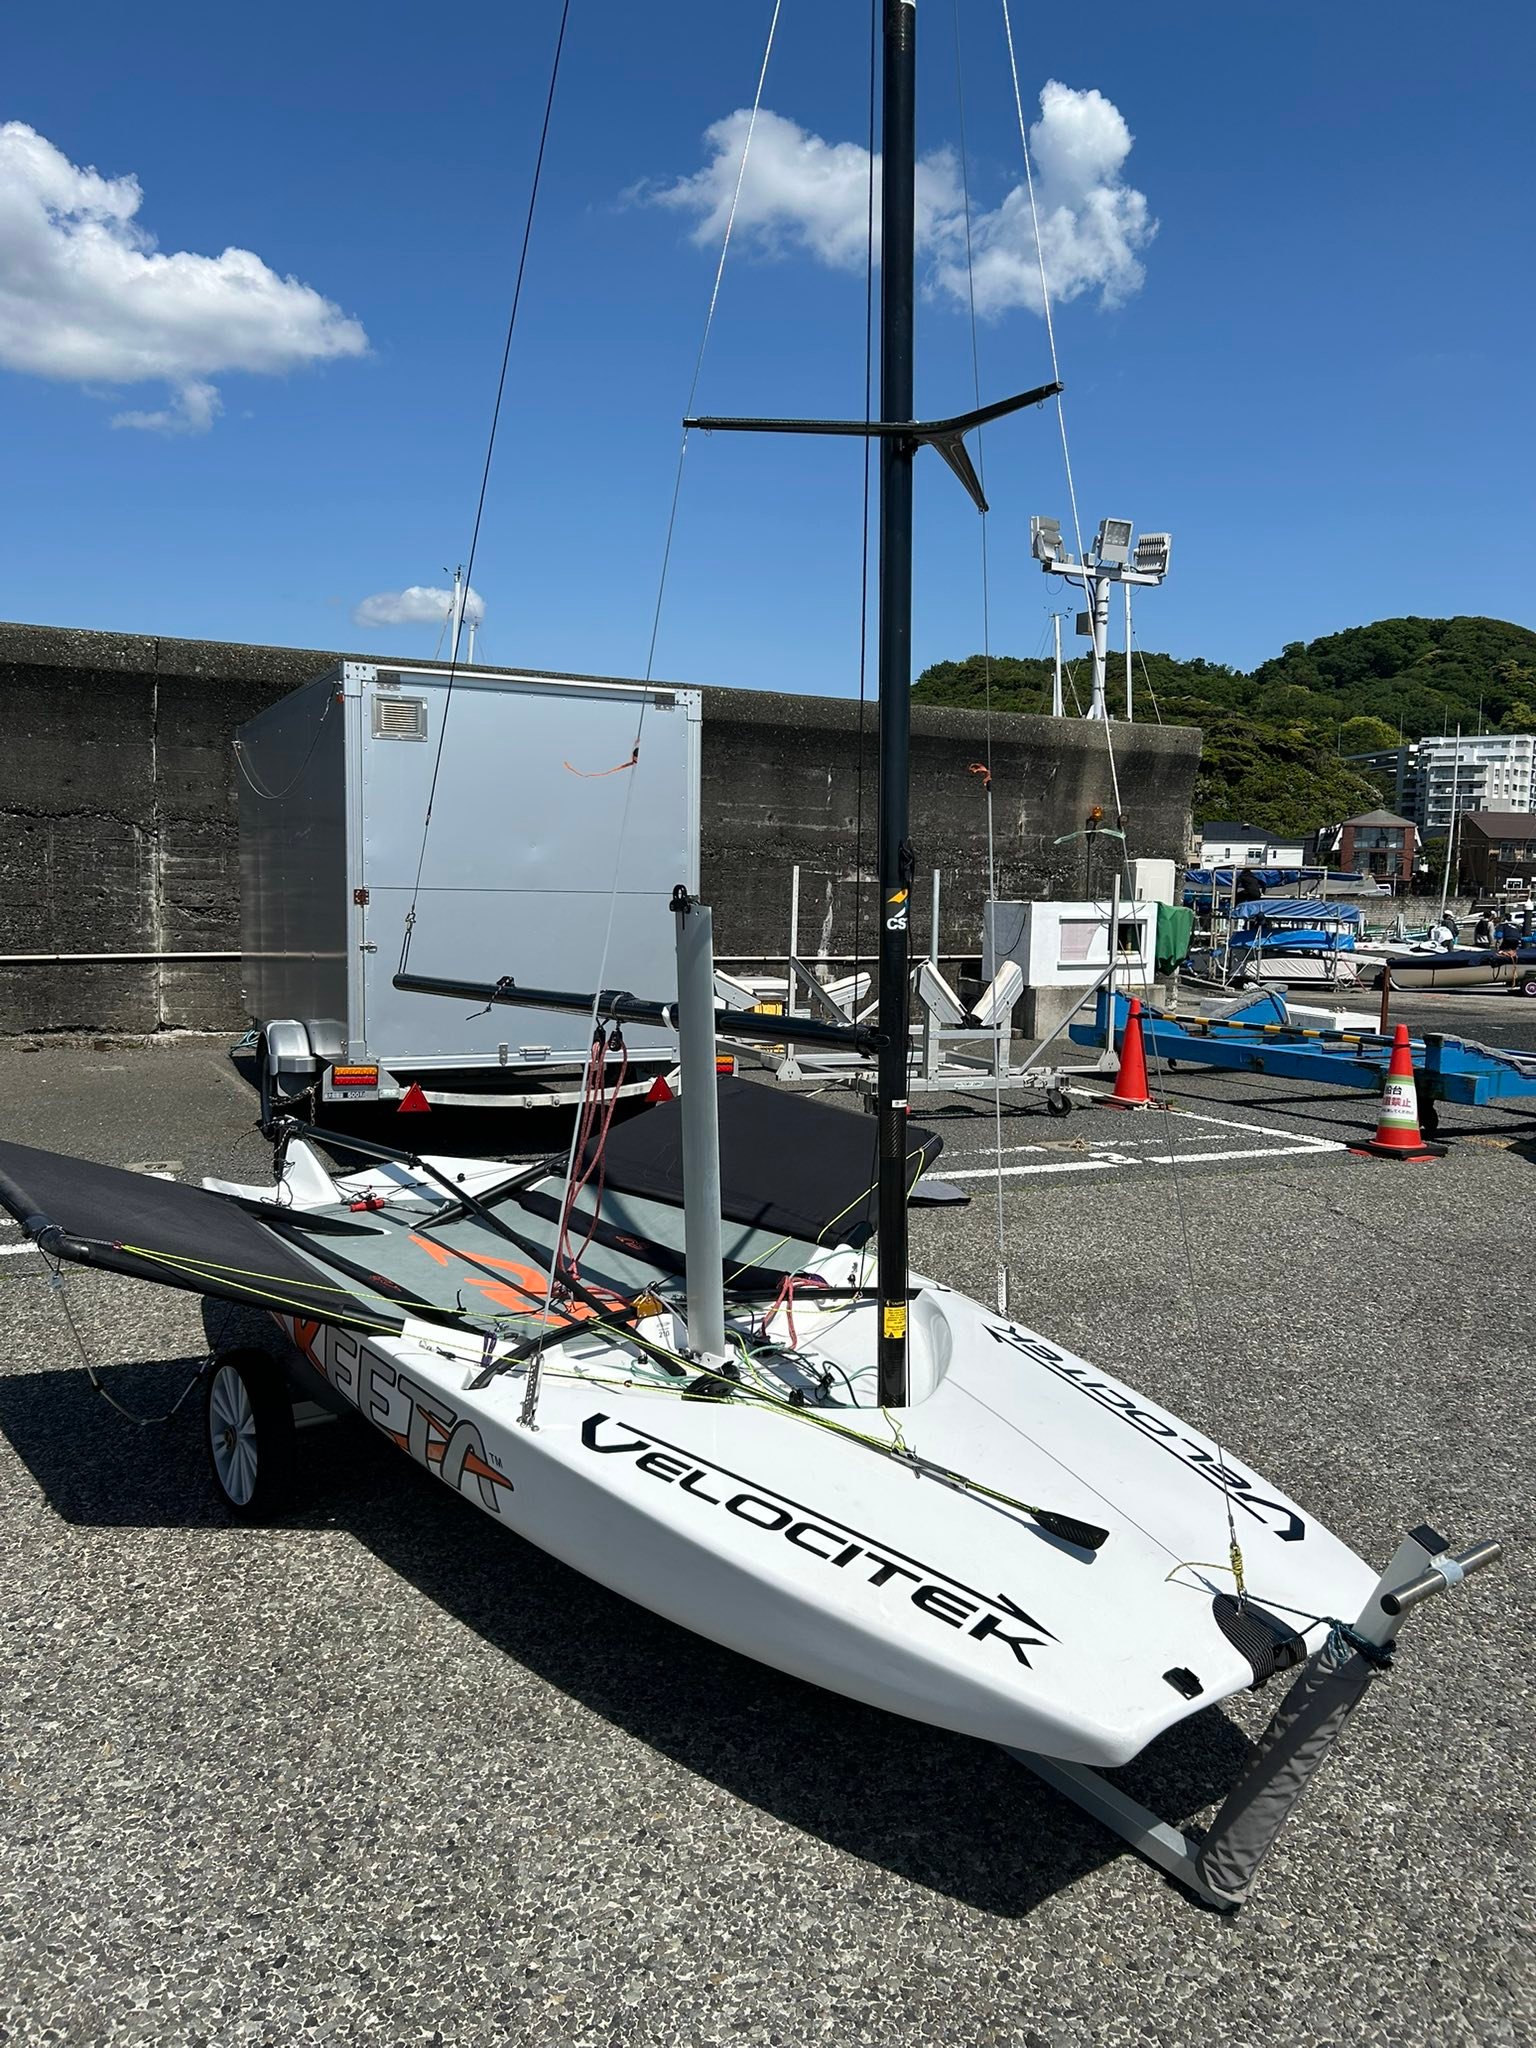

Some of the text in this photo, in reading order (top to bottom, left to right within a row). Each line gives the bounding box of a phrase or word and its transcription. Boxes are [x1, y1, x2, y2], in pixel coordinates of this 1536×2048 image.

[886, 917, 908, 930] CS
[581, 1412, 1048, 1670] VELOCITEK
[992, 1325, 1305, 1542] VELOCITEK
